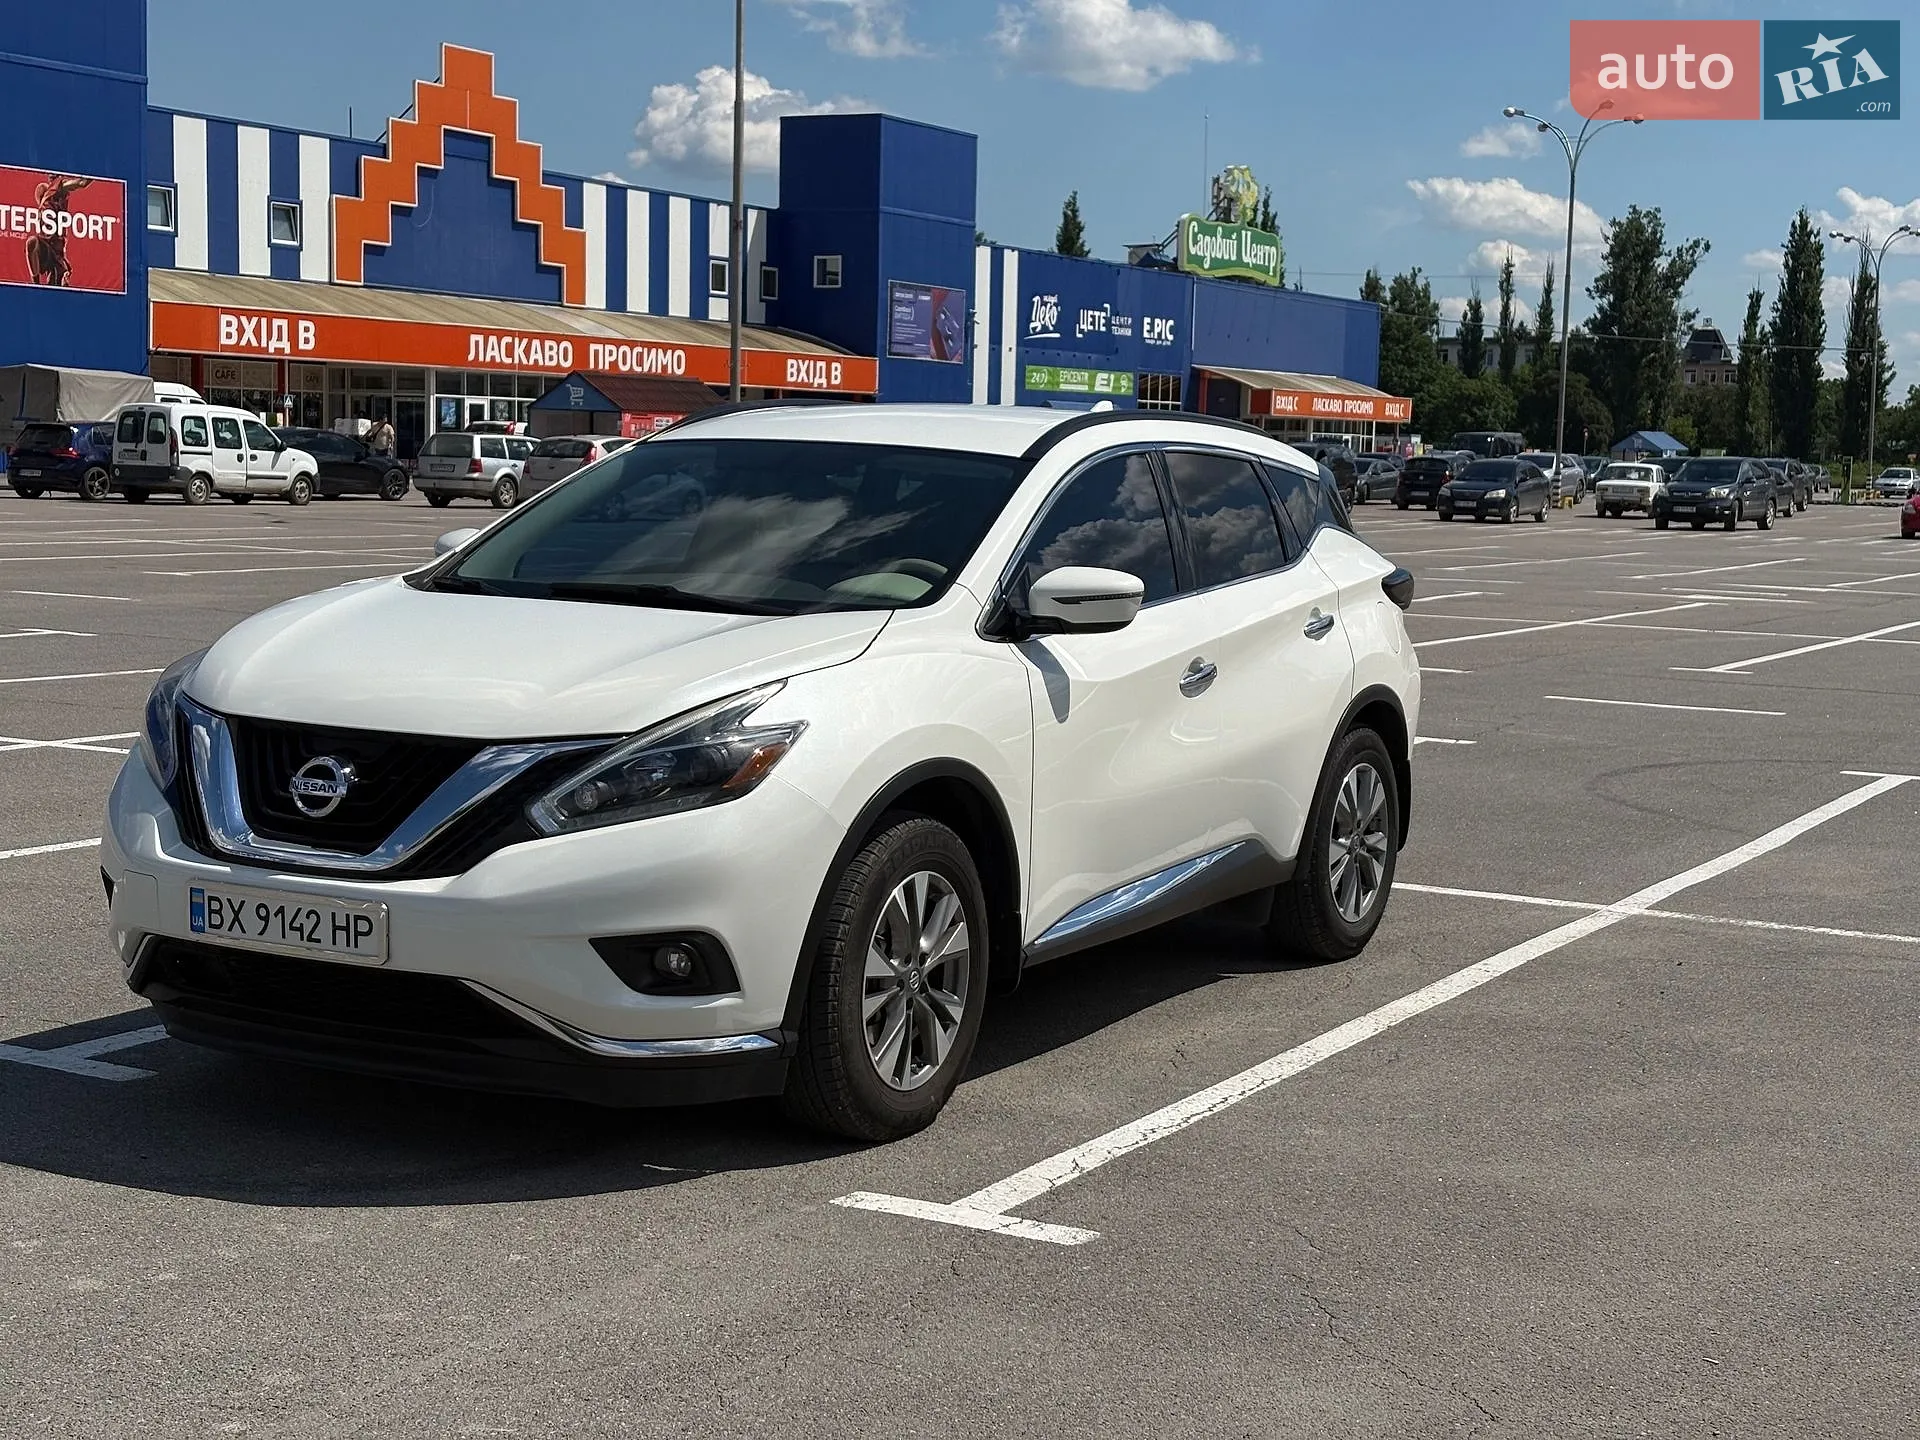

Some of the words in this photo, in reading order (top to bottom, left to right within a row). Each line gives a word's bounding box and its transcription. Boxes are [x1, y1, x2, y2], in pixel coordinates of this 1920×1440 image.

[1188, 220, 1237, 269] Садовий
[1241, 230, 1277, 276] Центр
[220, 313, 291, 355] ВХІД
[298, 319, 316, 351] В
[1143, 316, 1175, 341] E.PIC
[467, 333, 574, 368] ЛАСКАВО
[589, 343, 686, 375] ПРОСИМО
[215, 370, 236, 380] CAFE
[786, 358, 828, 388] ВХІД
[831, 361, 842, 385] В
[1275, 395, 1293, 411] ВХІД
[1312, 398, 1343, 413] ЛАСКАВО
[1344, 400, 1374, 415] ПРОСИМО
[1385, 403, 1400, 418] ВХІД
[293, 779, 338, 794] NISSAN
[192, 916, 204, 927] UA
[207, 895, 247, 935] BX
[255, 902, 322, 944] 9142
[331, 911, 374, 949] HP
